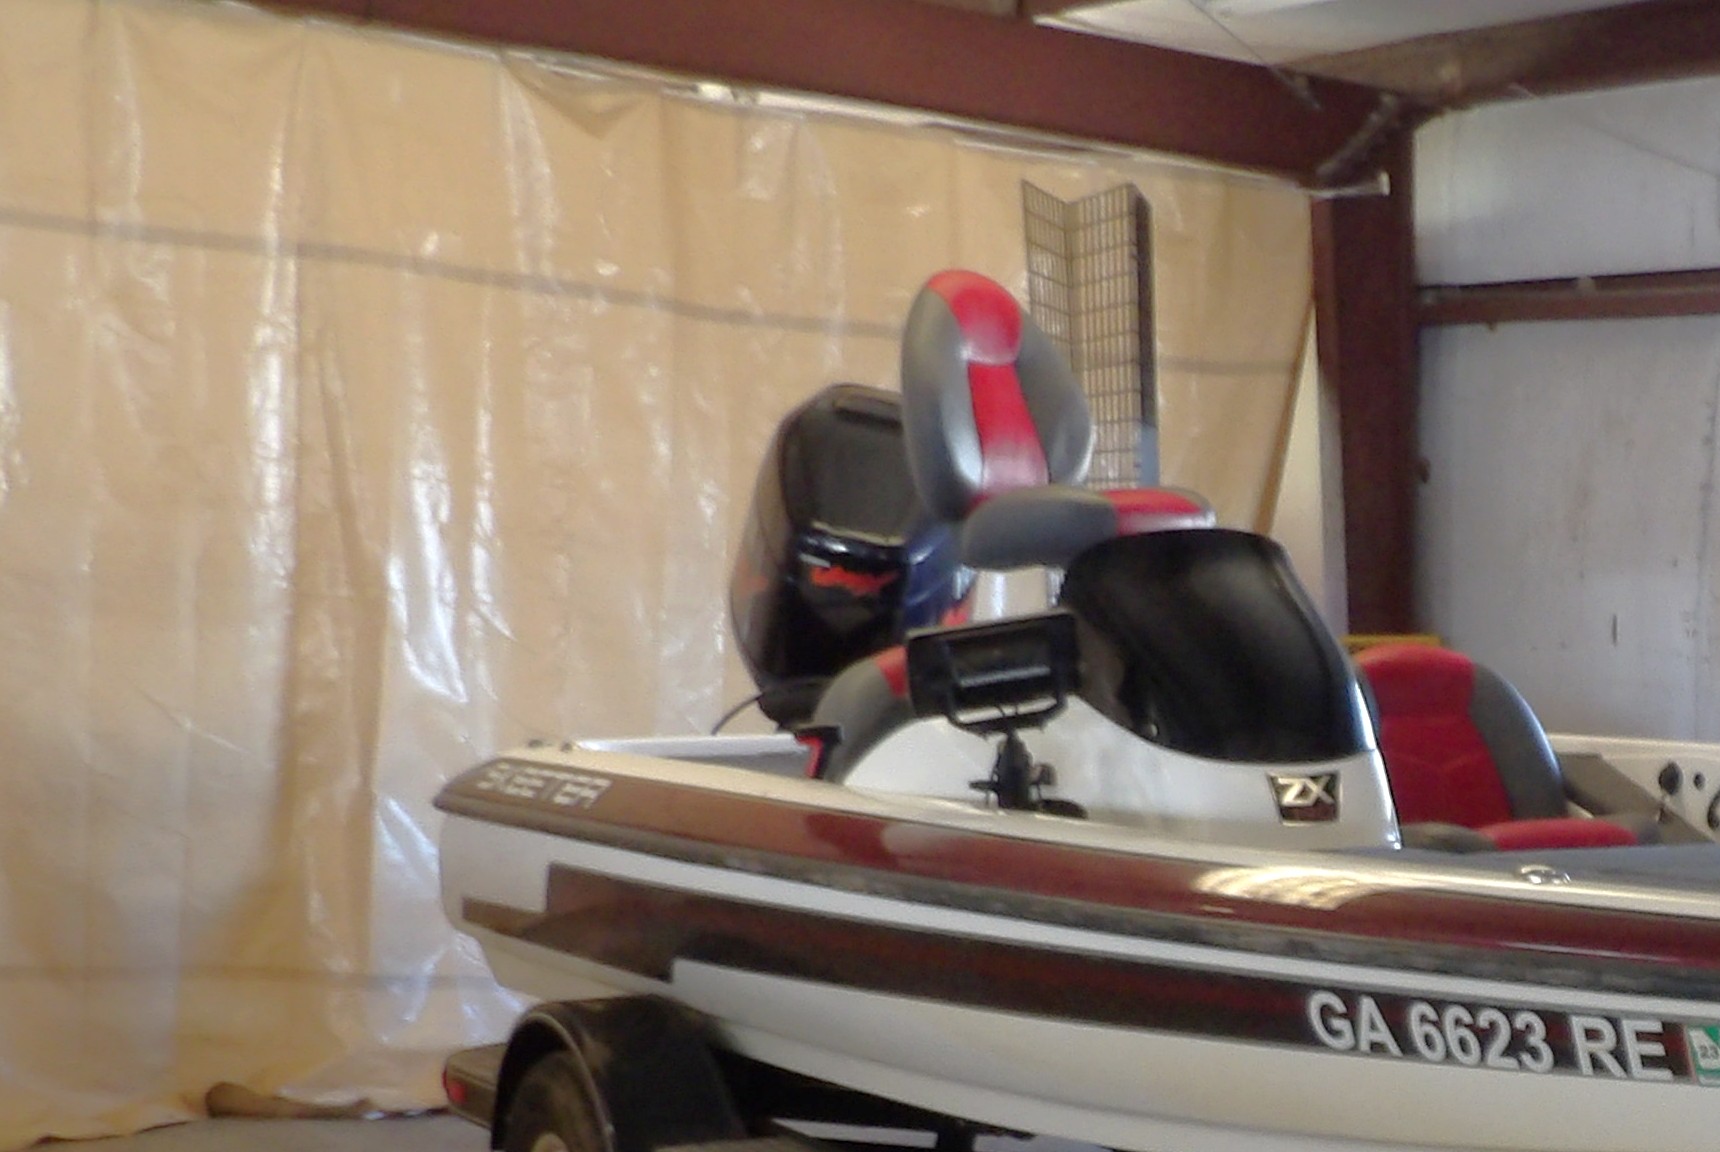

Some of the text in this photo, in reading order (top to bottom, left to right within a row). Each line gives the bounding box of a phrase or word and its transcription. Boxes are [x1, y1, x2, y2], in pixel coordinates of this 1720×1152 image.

[1278, 775, 1334, 806] ZX
[1307, 990, 1674, 1081] GA 6623 RE
